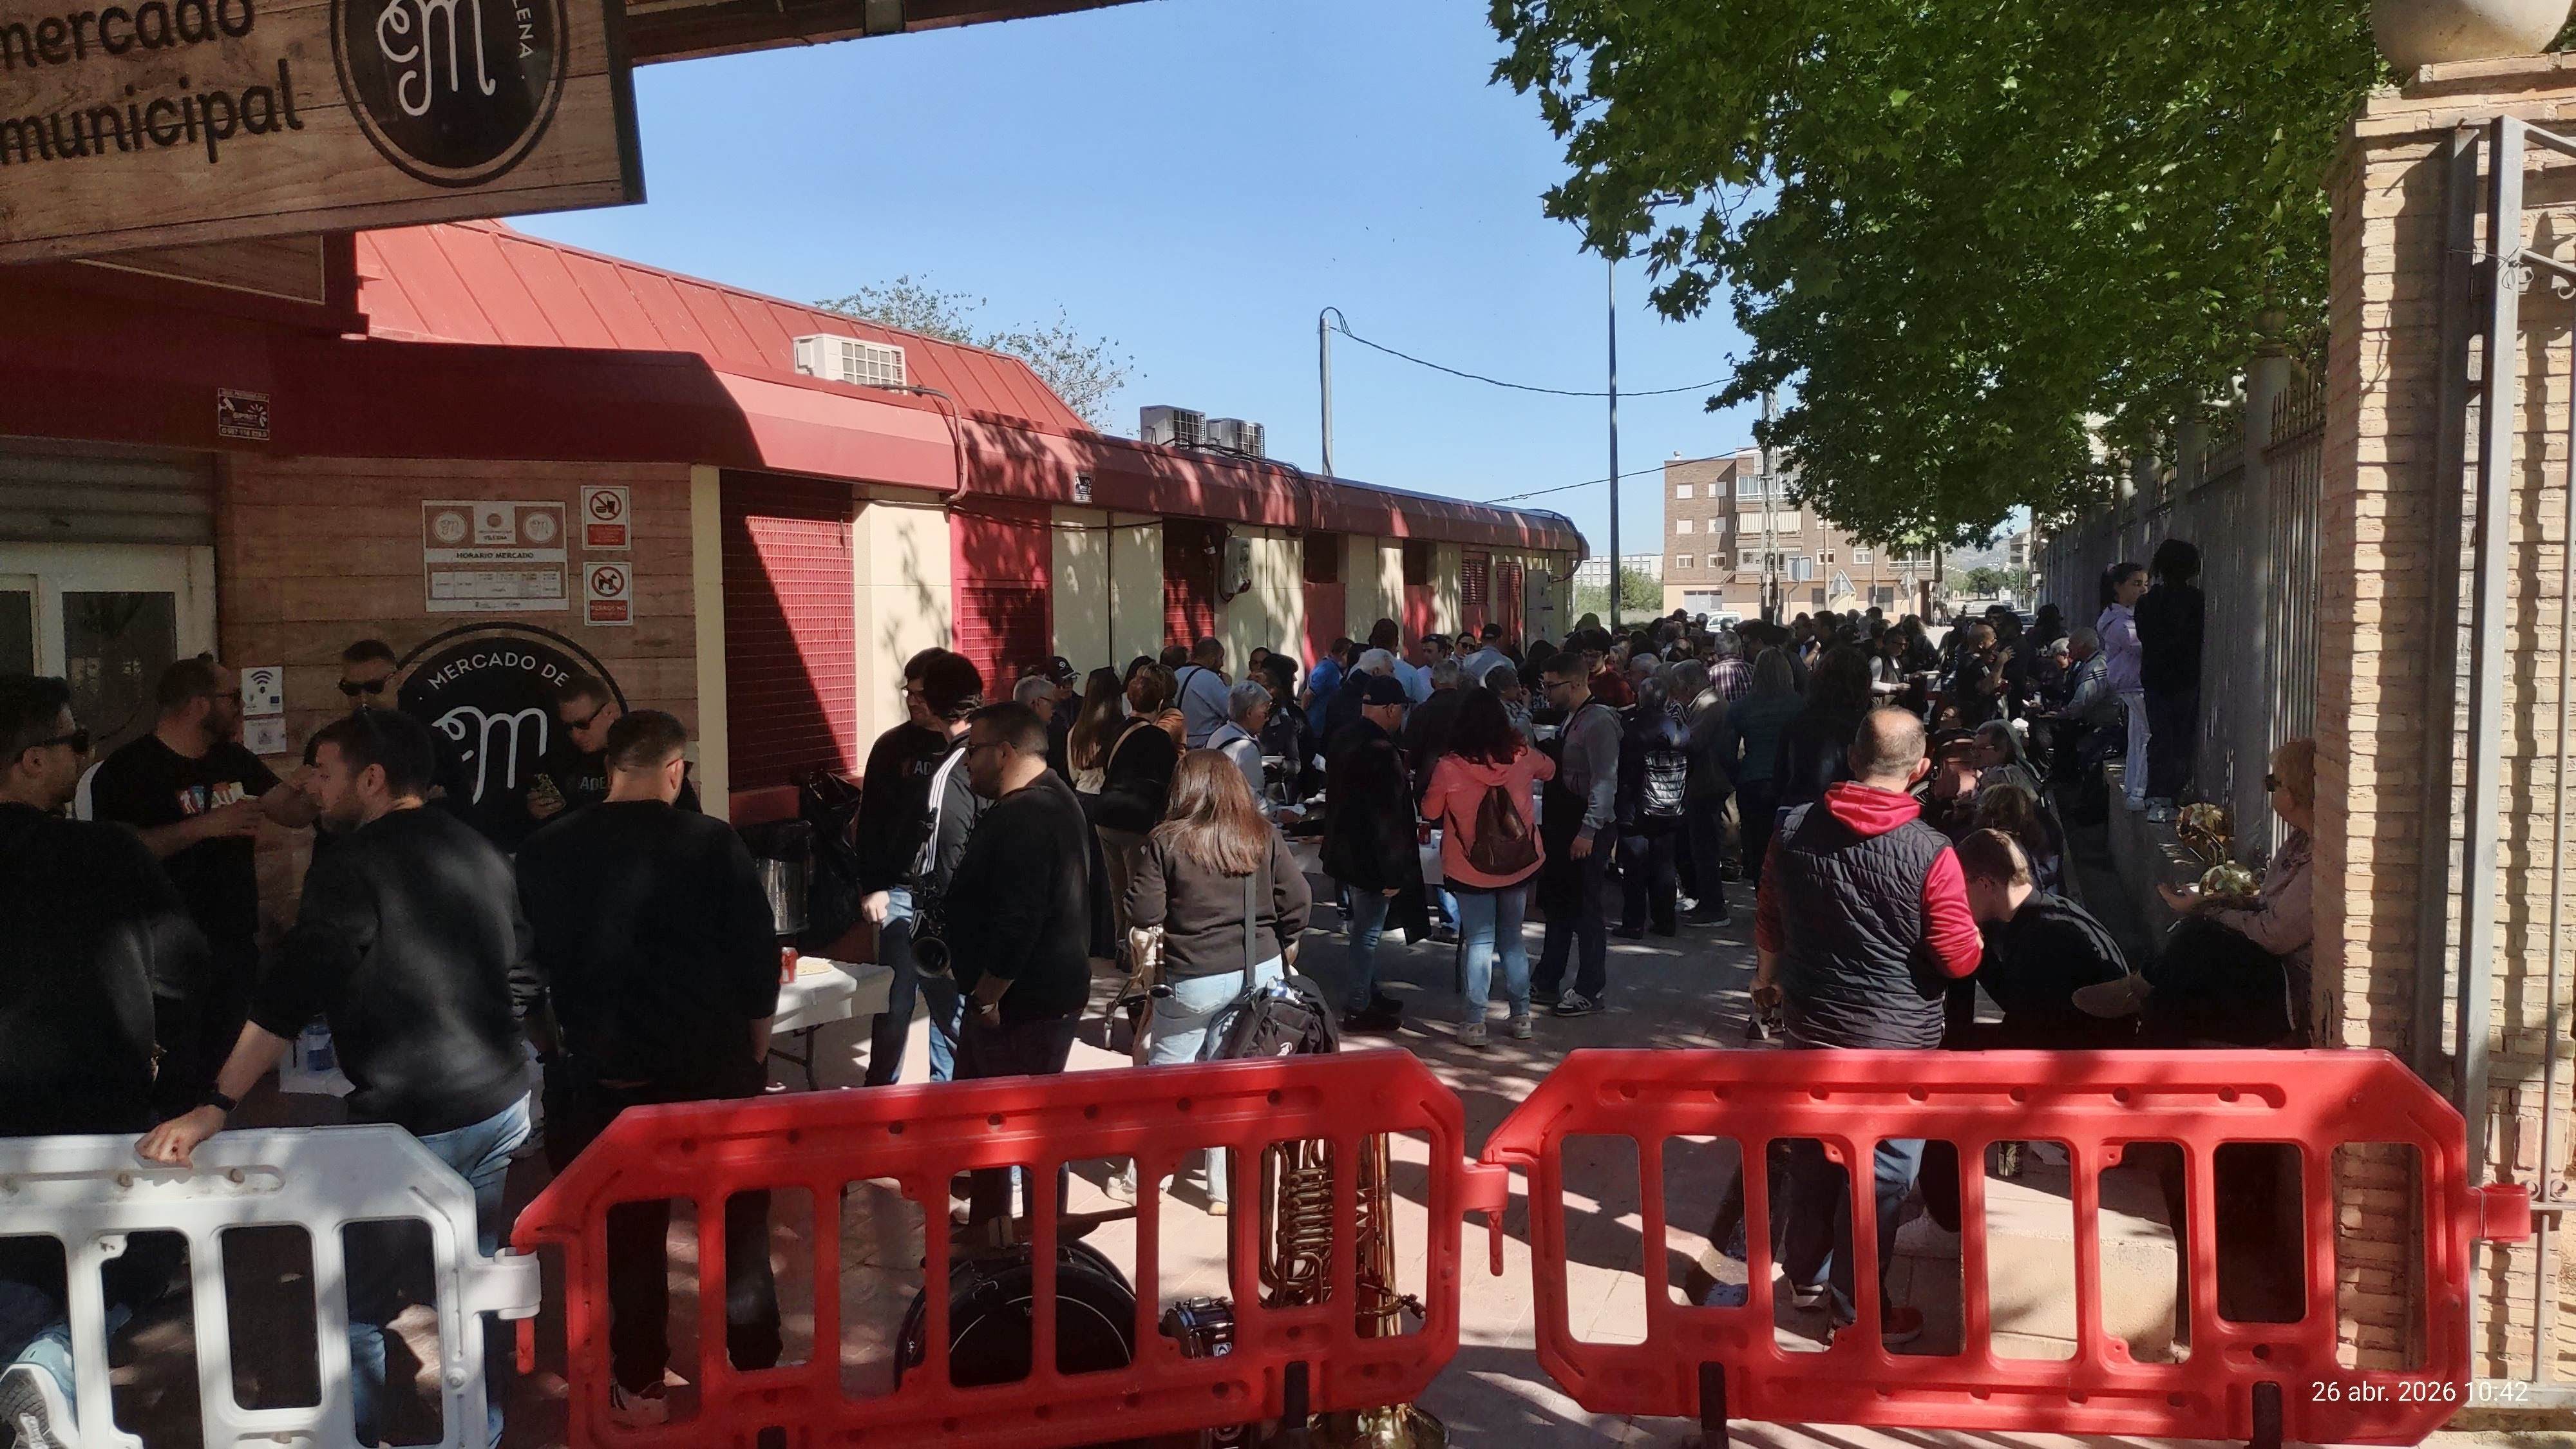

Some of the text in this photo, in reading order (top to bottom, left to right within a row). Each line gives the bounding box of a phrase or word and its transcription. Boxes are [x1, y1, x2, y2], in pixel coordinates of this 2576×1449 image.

[0, 58, 305, 164] municipal
[427, 651, 570, 690] MERCADO DE
